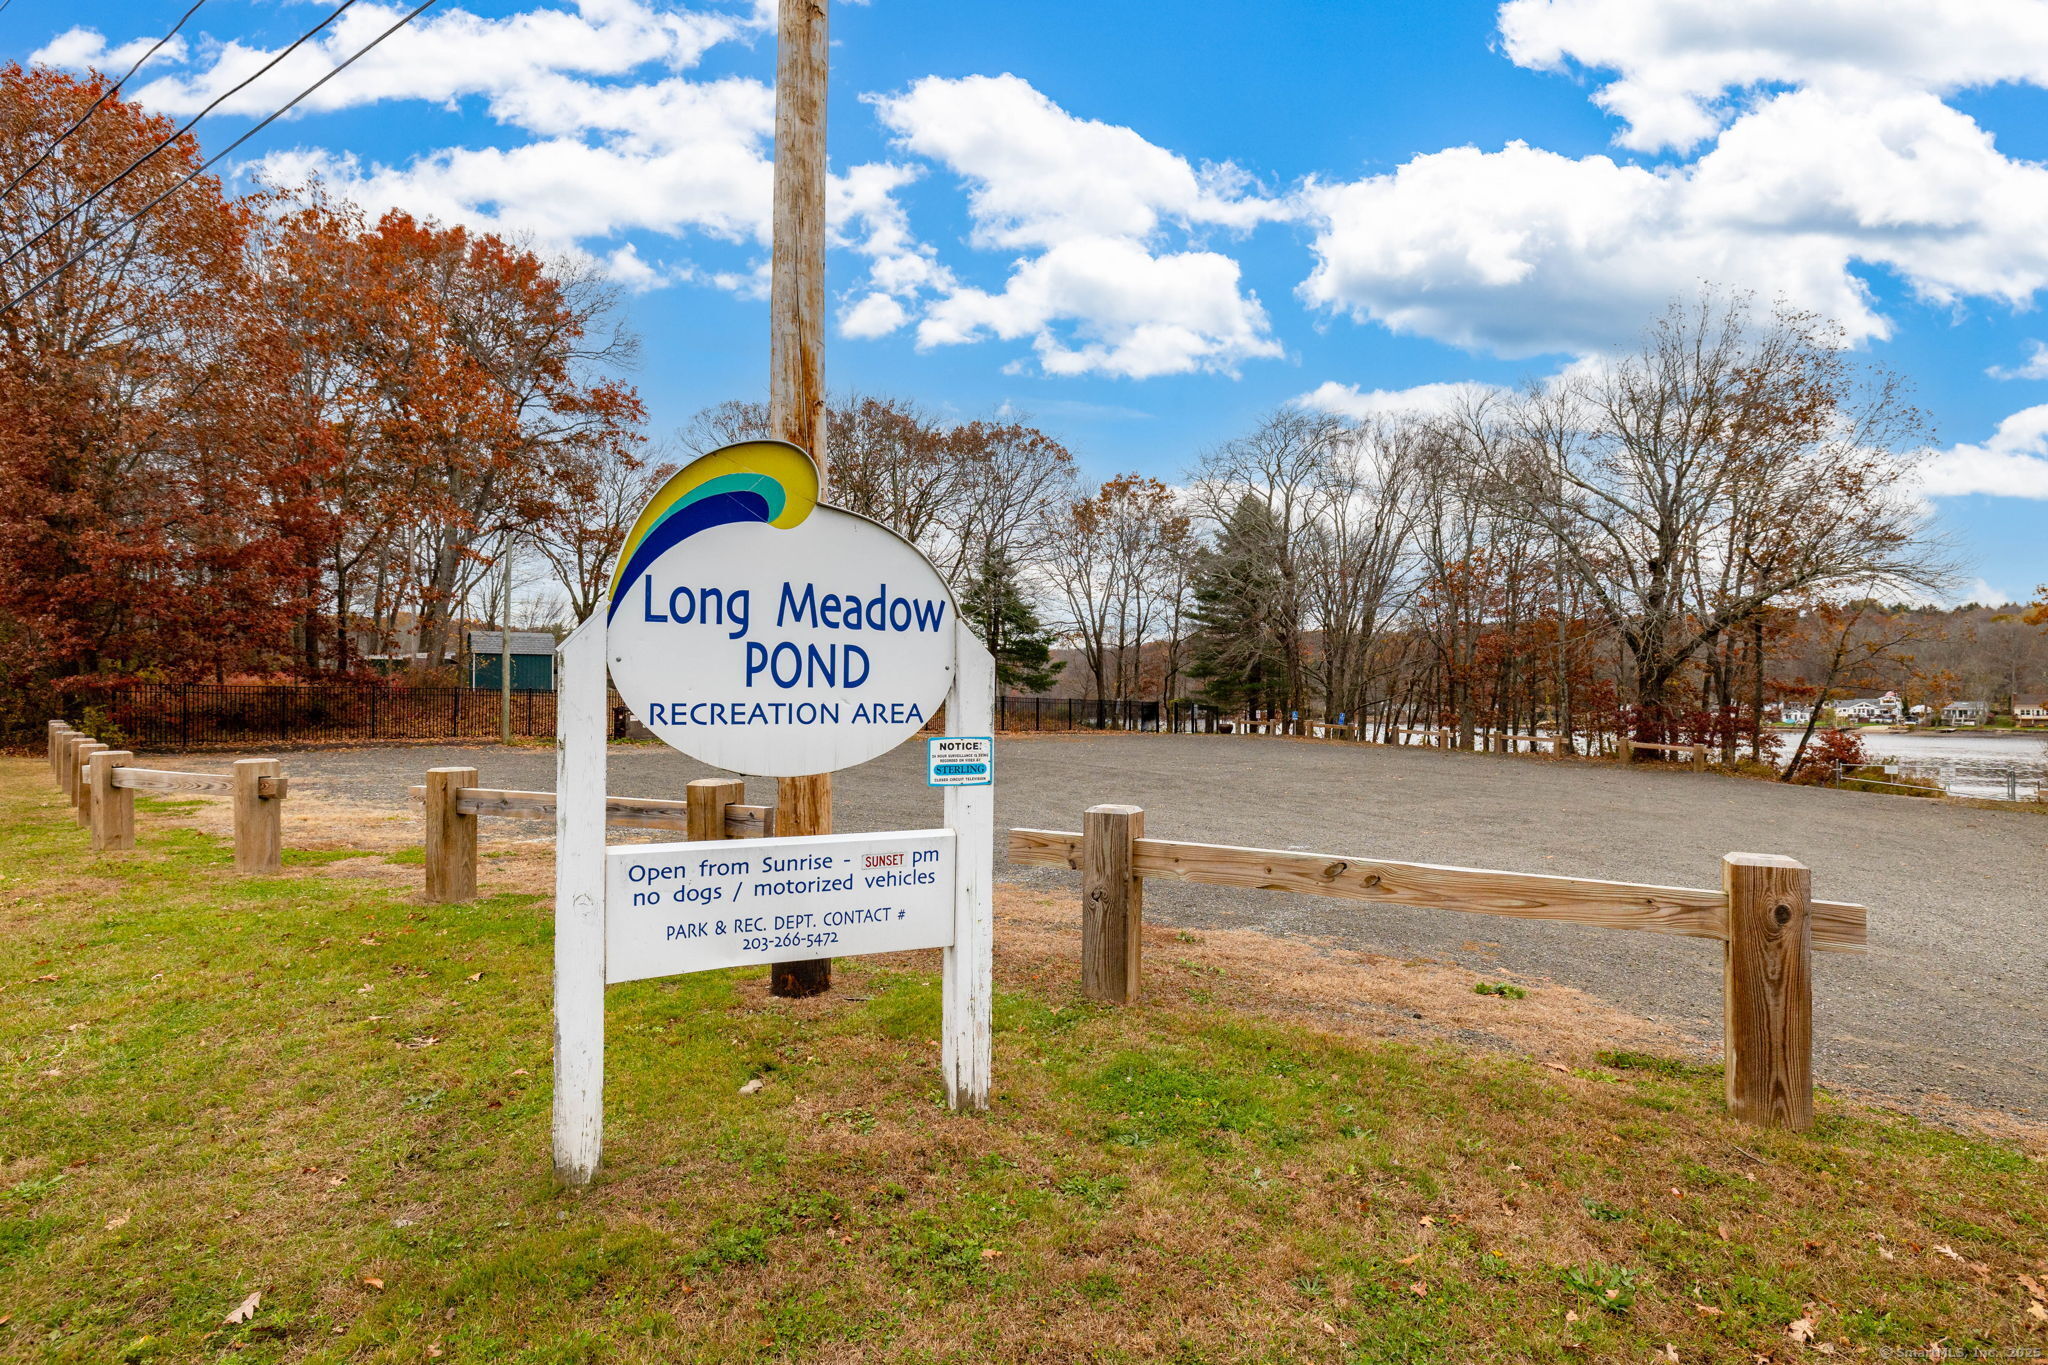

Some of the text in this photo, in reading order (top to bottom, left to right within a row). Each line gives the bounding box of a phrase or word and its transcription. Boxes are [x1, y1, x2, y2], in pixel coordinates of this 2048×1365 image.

[645, 574, 946, 640] Long Meadow
[746, 641, 870, 688] POND
[650, 702, 924, 726] RECREATION AREA
[936, 765, 984, 774] STERLING
[628, 863, 686, 885] Open
[699, 858, 749, 878] from
[762, 854, 833, 873] Sunrise
[865, 853, 904, 868] SUNSET
[912, 848, 939, 867] pm
[633, 869, 935, 907] no dogs / motorized vehicles
[666, 907, 906, 941] PARK & REC. DEPT. CONTACT #
[743, 932, 839, 951] 203-266-5472
